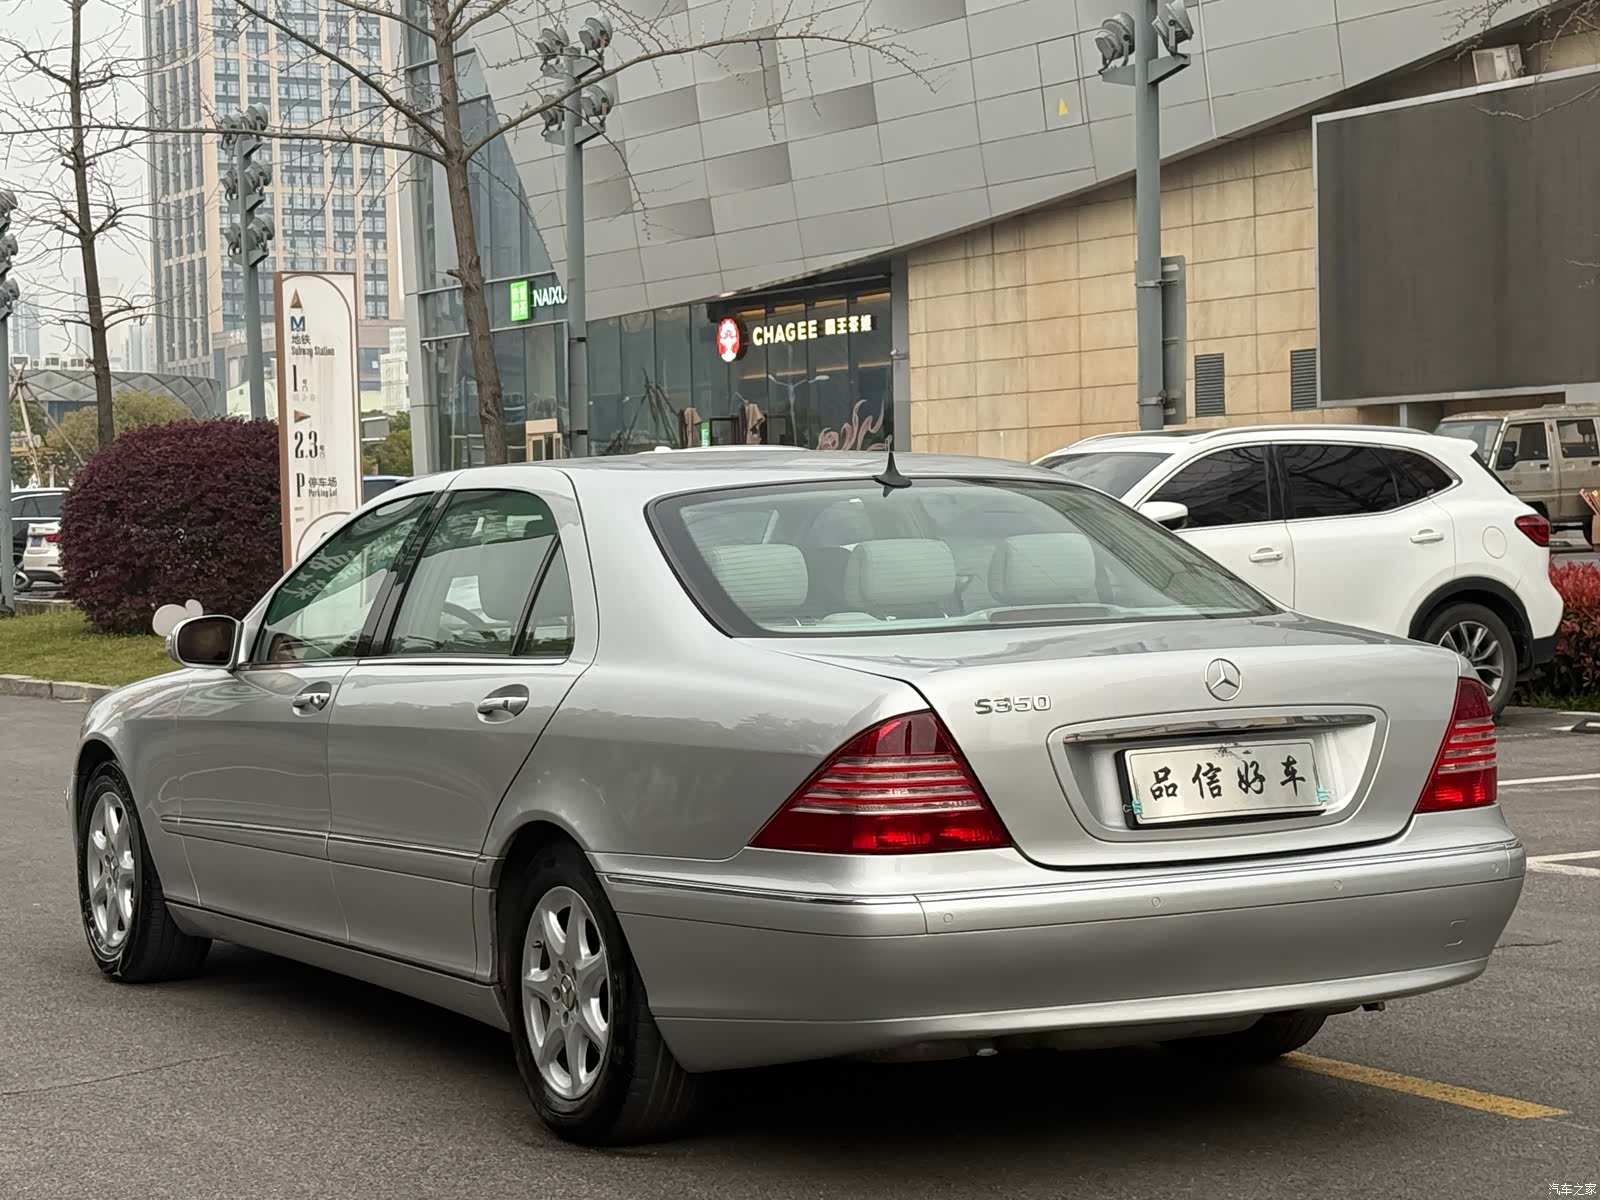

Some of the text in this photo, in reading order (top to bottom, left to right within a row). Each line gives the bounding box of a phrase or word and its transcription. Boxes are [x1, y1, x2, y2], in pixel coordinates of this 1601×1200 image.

[291, 334, 312, 345] 地铁
[753, 320, 818, 346] CHAGEE
[291, 346, 335, 358] Subway Station
[294, 431, 319, 459] 2.3
[296, 473, 338, 498] P 停车场
[308, 488, 338, 498] Parking Lot
[974, 695, 1052, 715] S350
[1150, 755, 1307, 801] 品信好车
